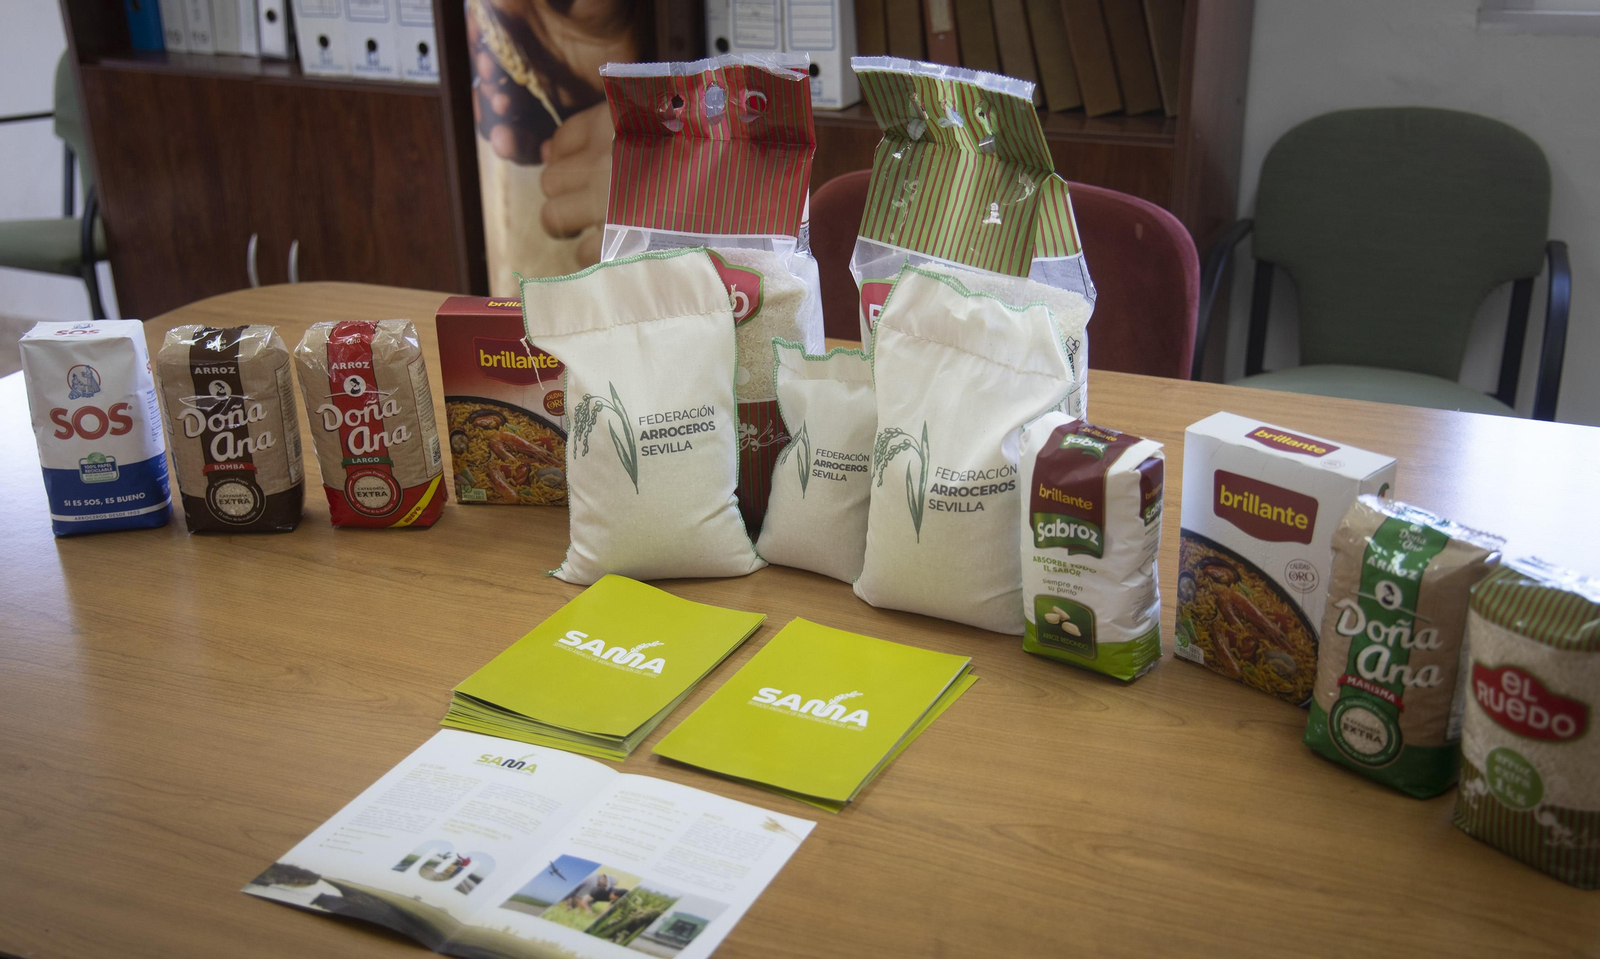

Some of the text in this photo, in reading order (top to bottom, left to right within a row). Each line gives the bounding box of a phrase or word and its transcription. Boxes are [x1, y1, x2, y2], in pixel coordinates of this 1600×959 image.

[332, 362, 370, 370] ARROZ
[480, 350, 559, 369] brillante
[194, 366, 236, 374] ARROZ
[50, 402, 133, 440] SOS
[176, 403, 268, 438] Doña
[316, 399, 402, 432] Doña
[638, 405, 715, 426] FEDERACIÓN
[640, 420, 716, 441] ARROCEROS
[210, 431, 277, 462] Ana
[348, 426, 412, 456] Ana
[641, 440, 693, 456] SEVILLA
[1254, 430, 1327, 454] brillante
[816, 448, 870, 462] FEDERACIÓN
[813, 459, 868, 472] ARROCEROS
[935, 464, 1018, 482] FEDERACIÓN
[812, 469, 848, 482] SEVILLA
[106, 496, 115, 504] ES
[116, 492, 146, 502] BUENO
[930, 480, 1016, 498] ARROCEROS
[1038, 483, 1094, 510] brillante
[928, 498, 985, 512] SEVILLA
[1220, 484, 1309, 530] brillante
[404, 506, 422, 524] NUEVO
[1037, 518, 1099, 546] Sabroz
[1032, 556, 1098, 574] ABSORBE TODO
[1052, 566, 1082, 578] SABOR
[1290, 562, 1311, 570] CALIDAD
[1367, 556, 1419, 581] ARROZ
[1042, 578, 1071, 588] siempre
[1288, 570, 1315, 582] ORO
[1056, 586, 1078, 596] punto
[1332, 598, 1444, 650] Doña
[1042, 632, 1089, 650] ARROZ REDONDO
[558, 630, 666, 674] SAMA
[1356, 644, 1445, 689] Ana
[1346, 676, 1396, 703] MARISMA
[752, 687, 869, 728] SAMA
[1342, 722, 1384, 746] EXTRA
[476, 754, 538, 774] SAMA
